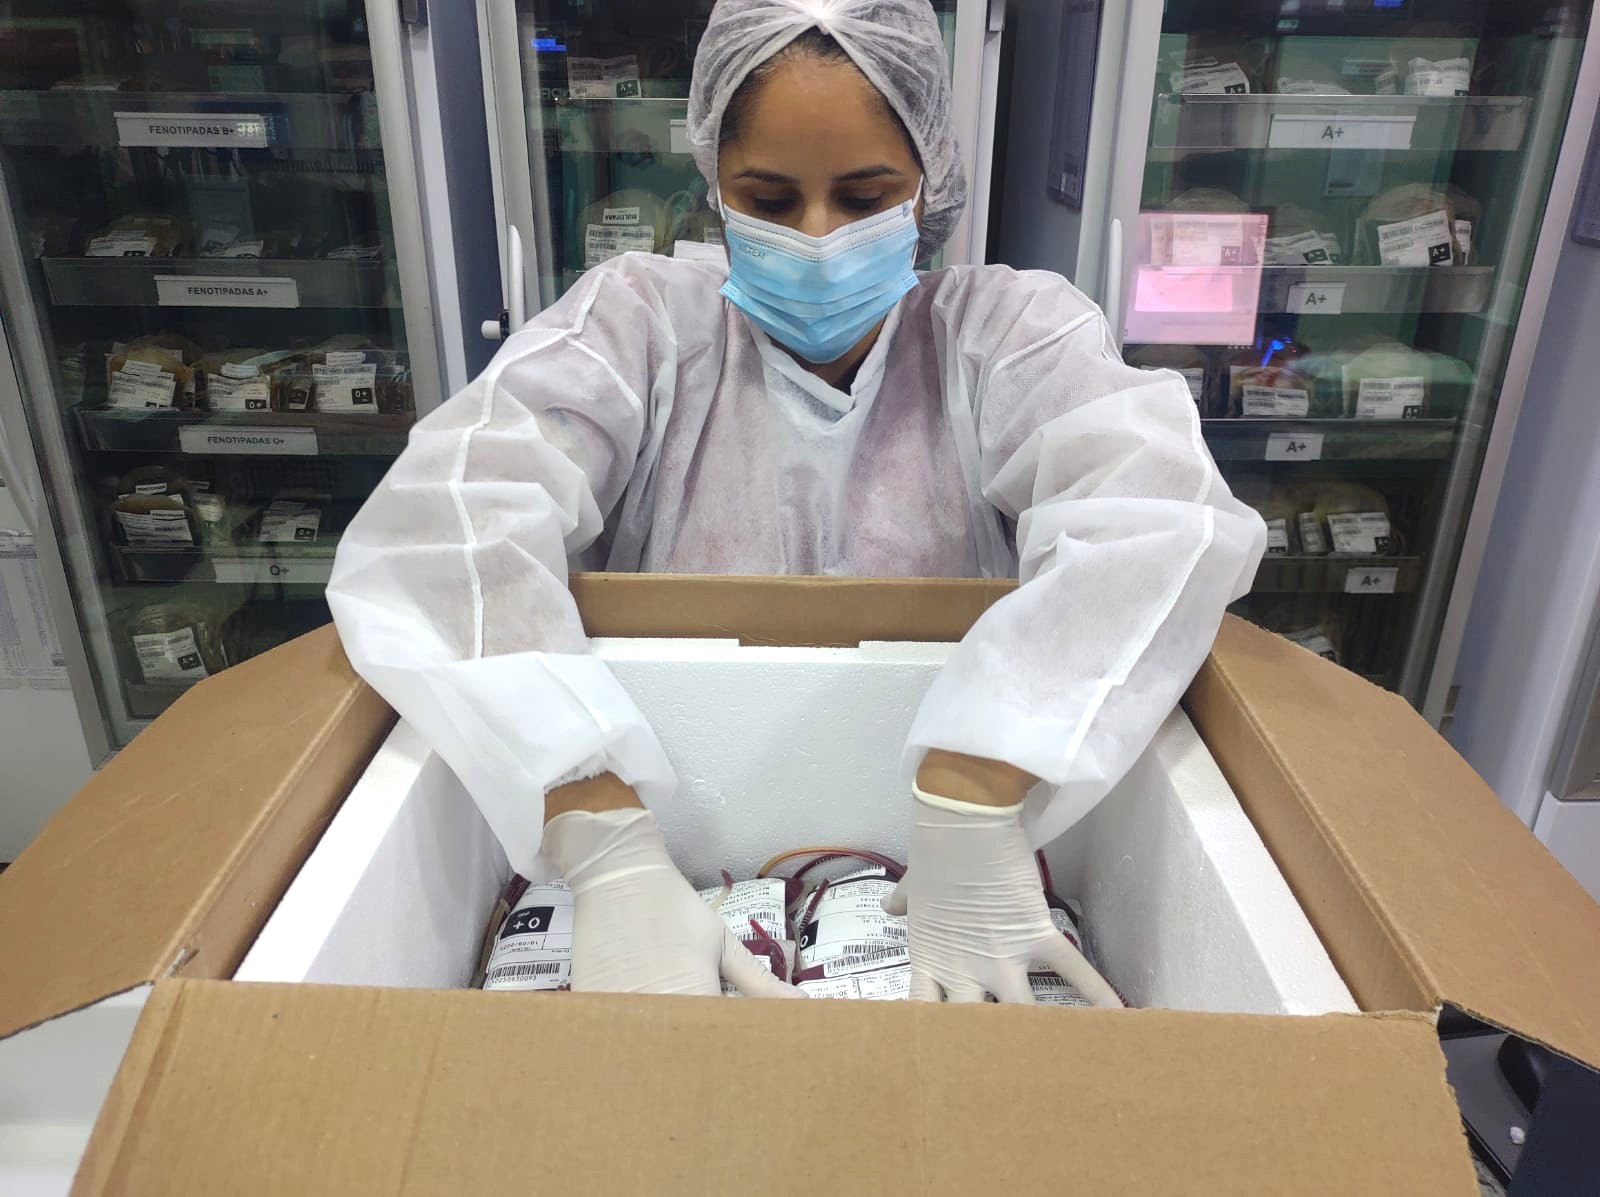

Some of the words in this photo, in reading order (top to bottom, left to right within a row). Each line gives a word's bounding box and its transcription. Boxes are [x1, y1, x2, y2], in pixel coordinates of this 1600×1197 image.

[149, 125, 220, 136] FENOTIPADAS
[222, 126, 235, 135] B+
[1321, 125, 1345, 140] A+
[187, 287, 254, 297] FENOTIPADAS
[255, 287, 269, 296] A+
[1305, 292, 1327, 306] A+
[207, 436, 271, 446] FENOTIPADAS
[272, 436, 285, 445] O+
[1286, 441, 1307, 454] A+
[1360, 575, 1382, 587] A+
[513, 917, 541, 930] O+
